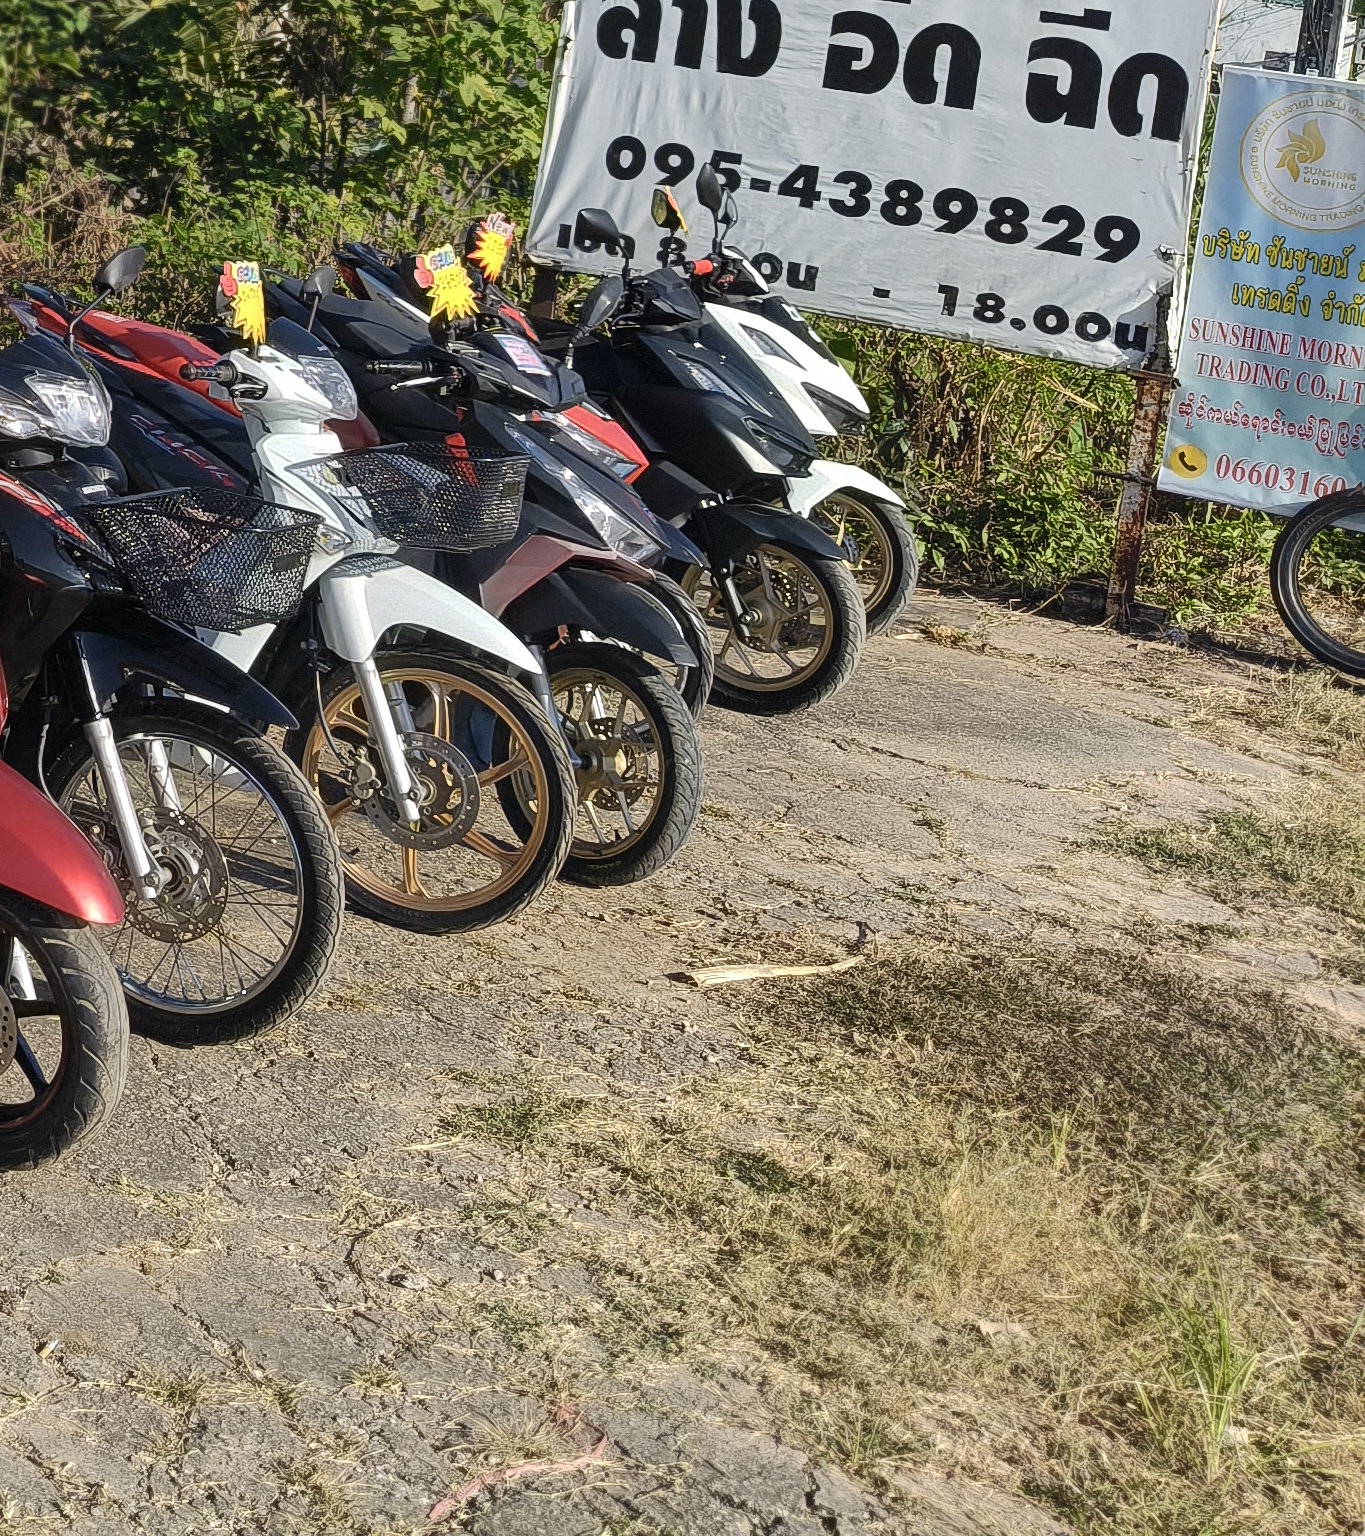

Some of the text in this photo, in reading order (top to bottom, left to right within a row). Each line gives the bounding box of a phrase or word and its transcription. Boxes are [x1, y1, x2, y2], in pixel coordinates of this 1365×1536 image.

[1025, 8, 1189, 142] ฉีด
[1303, 166, 1357, 182] SUNSHINE
[606, 135, 1140, 263] 095-4389829
[1202, 227, 1260, 265] บริษัท
[1266, 234, 1356, 279] ซันชายน์
[1189, 317, 1292, 357] SUNSHINE
[1196, 352, 1290, 391] TRADING
[1216, 453, 1363, 500] 06603160
